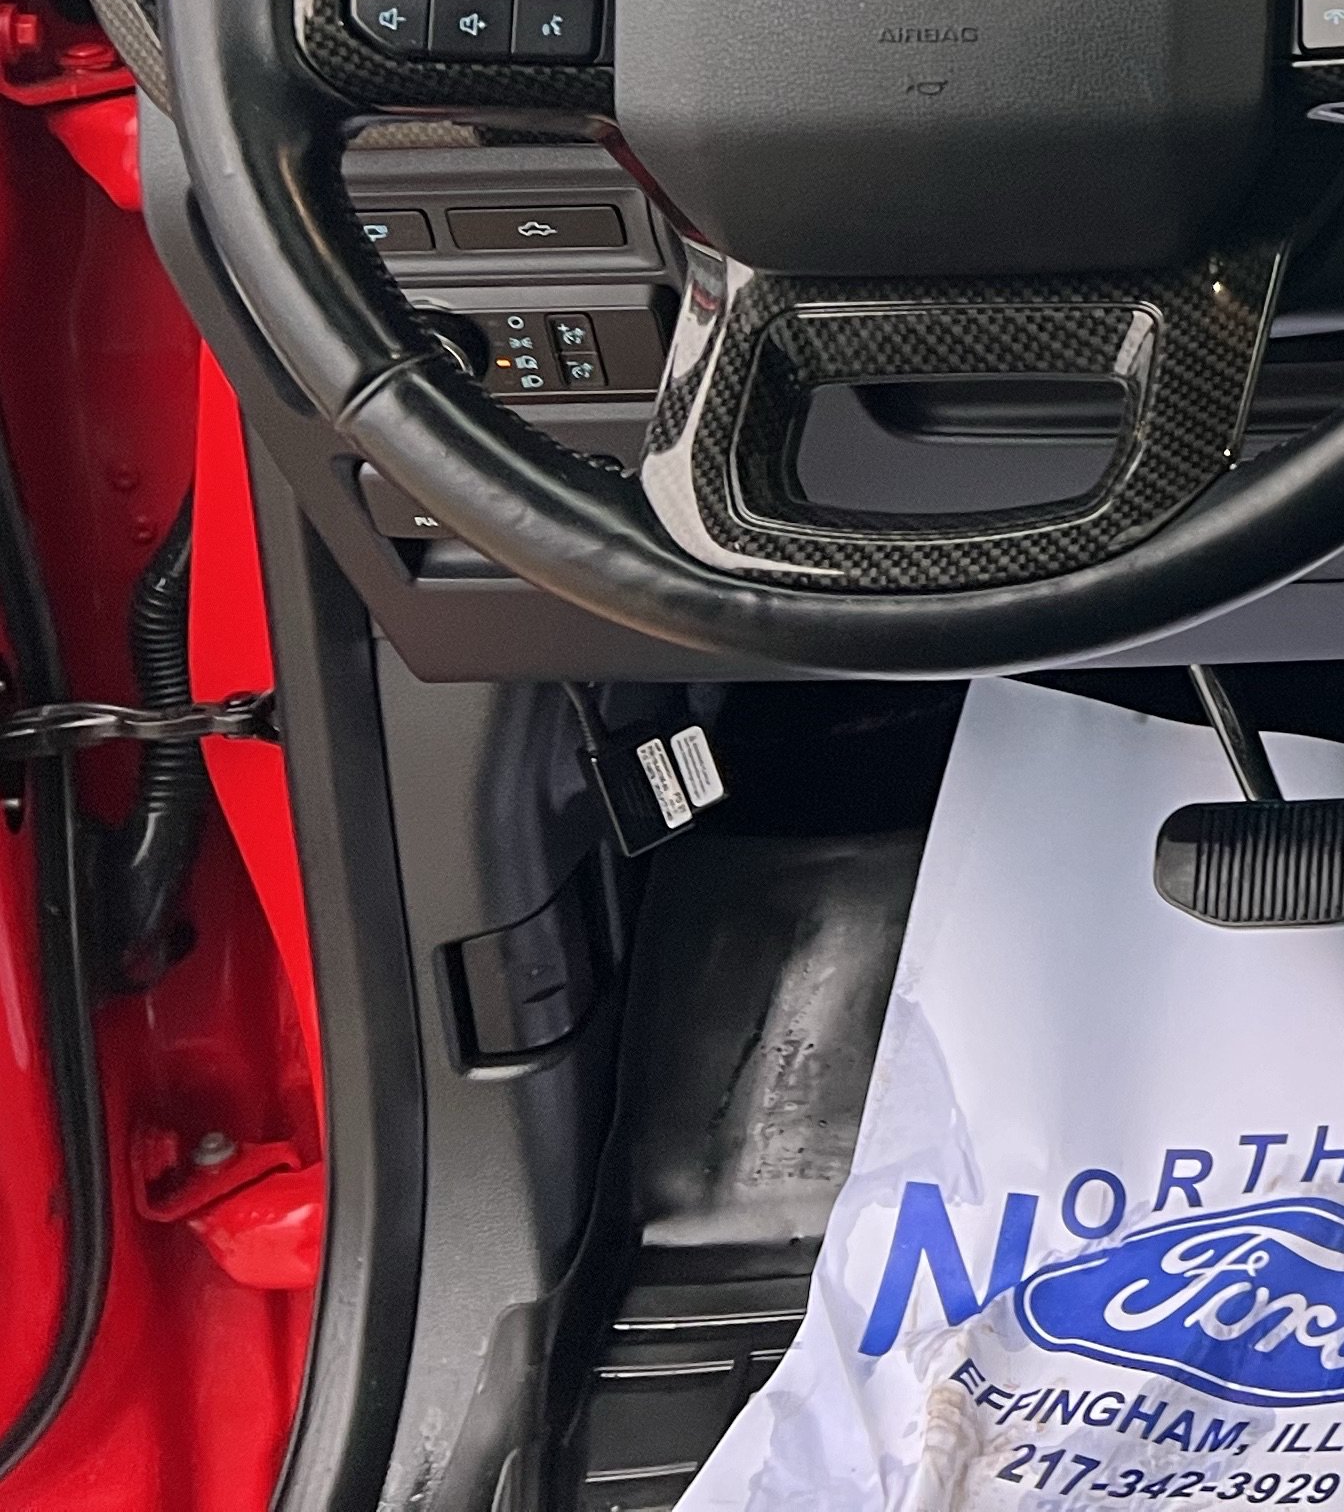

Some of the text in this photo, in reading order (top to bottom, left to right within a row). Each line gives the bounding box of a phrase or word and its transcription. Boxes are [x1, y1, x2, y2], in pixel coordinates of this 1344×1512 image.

[879, 27, 979, 44] AIRBAG
[948, 1357, 1250, 1457] EFFINGHAM,
[996, 1443, 1341, 1505] 217-342-3929
